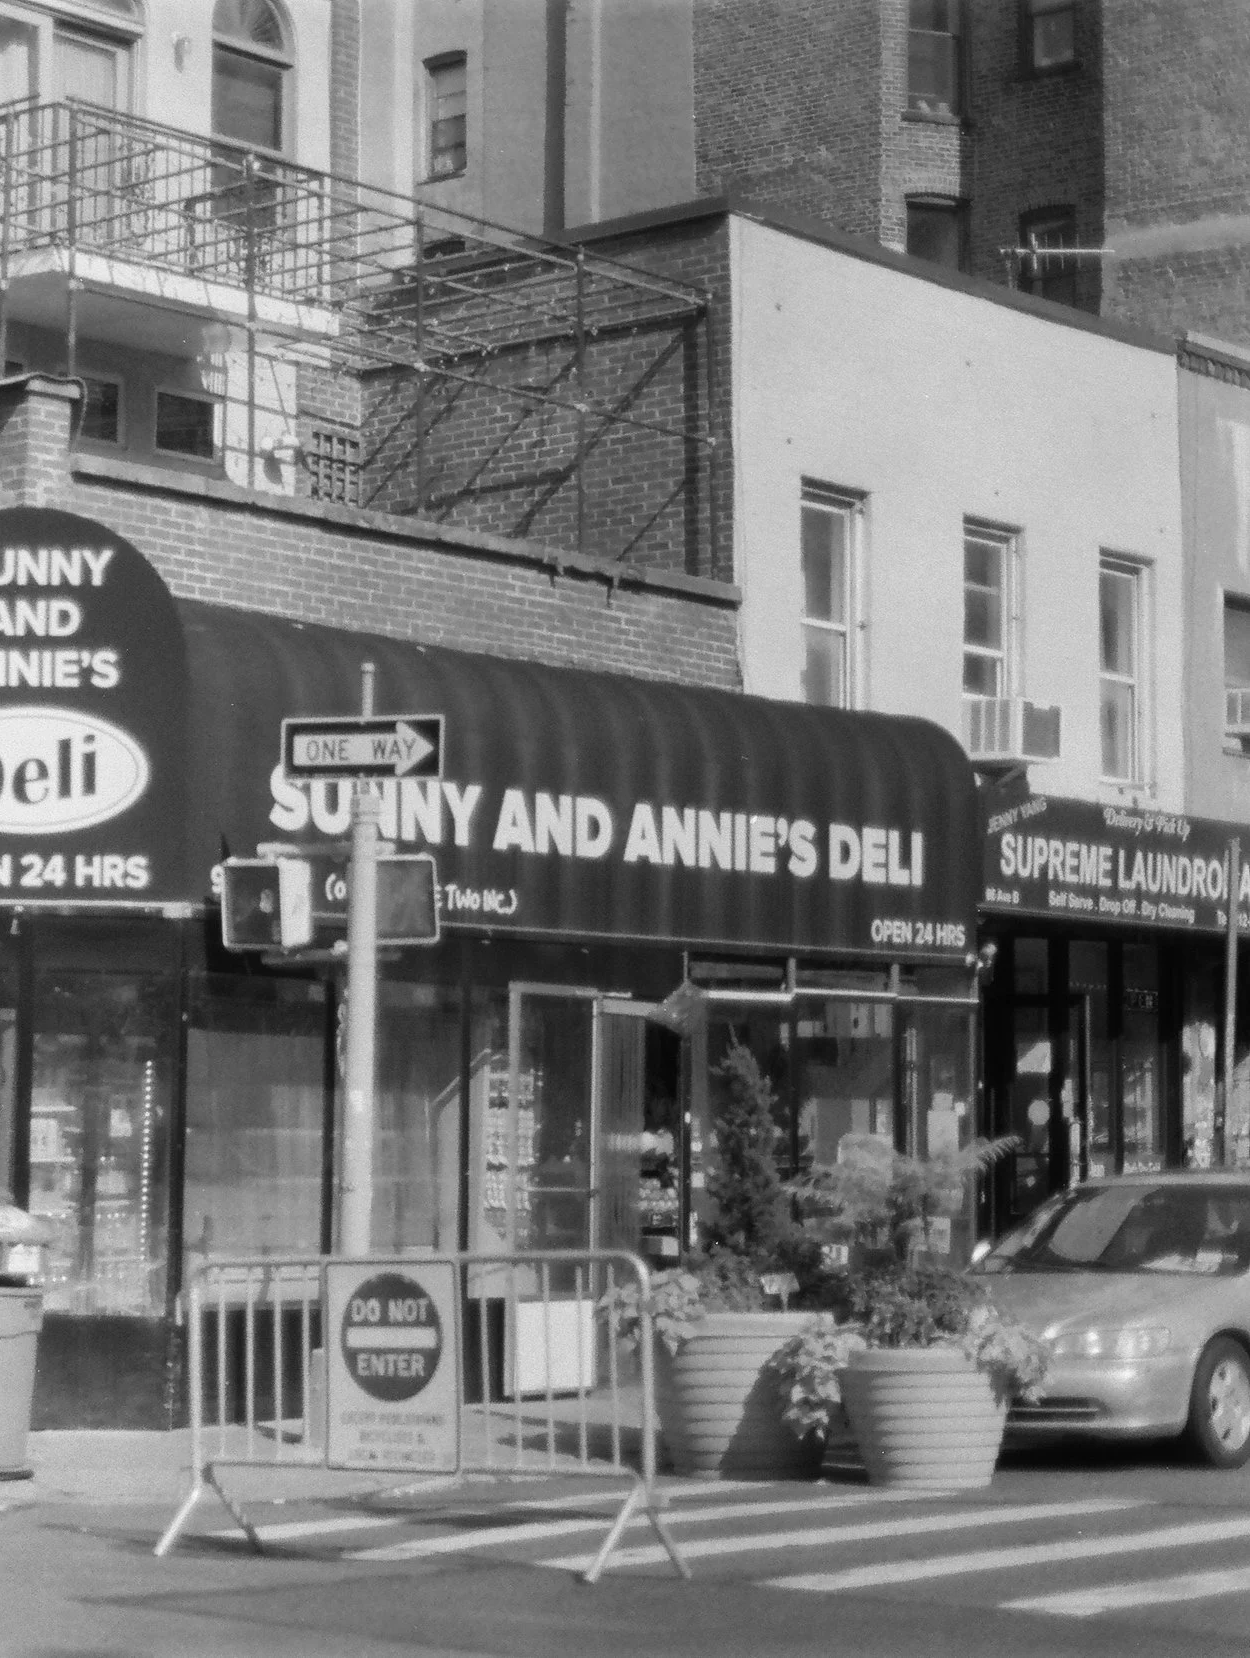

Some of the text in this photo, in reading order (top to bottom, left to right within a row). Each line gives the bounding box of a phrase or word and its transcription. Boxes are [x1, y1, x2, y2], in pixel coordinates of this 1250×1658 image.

[306, 737, 417, 761] ONE WAY
[493, 789, 613, 858] AND
[624, 803, 817, 877] ANNIE'S
[830, 824, 923, 886] DELI
[21, 854, 66, 886] 24
[75, 855, 149, 888] HRS
[1001, 833, 1112, 887] SUPREME
[871, 919, 965, 947] OPEN 24 HRS
[351, 1299, 430, 1322] DO NOT
[357, 1354, 425, 1377] ENTER
